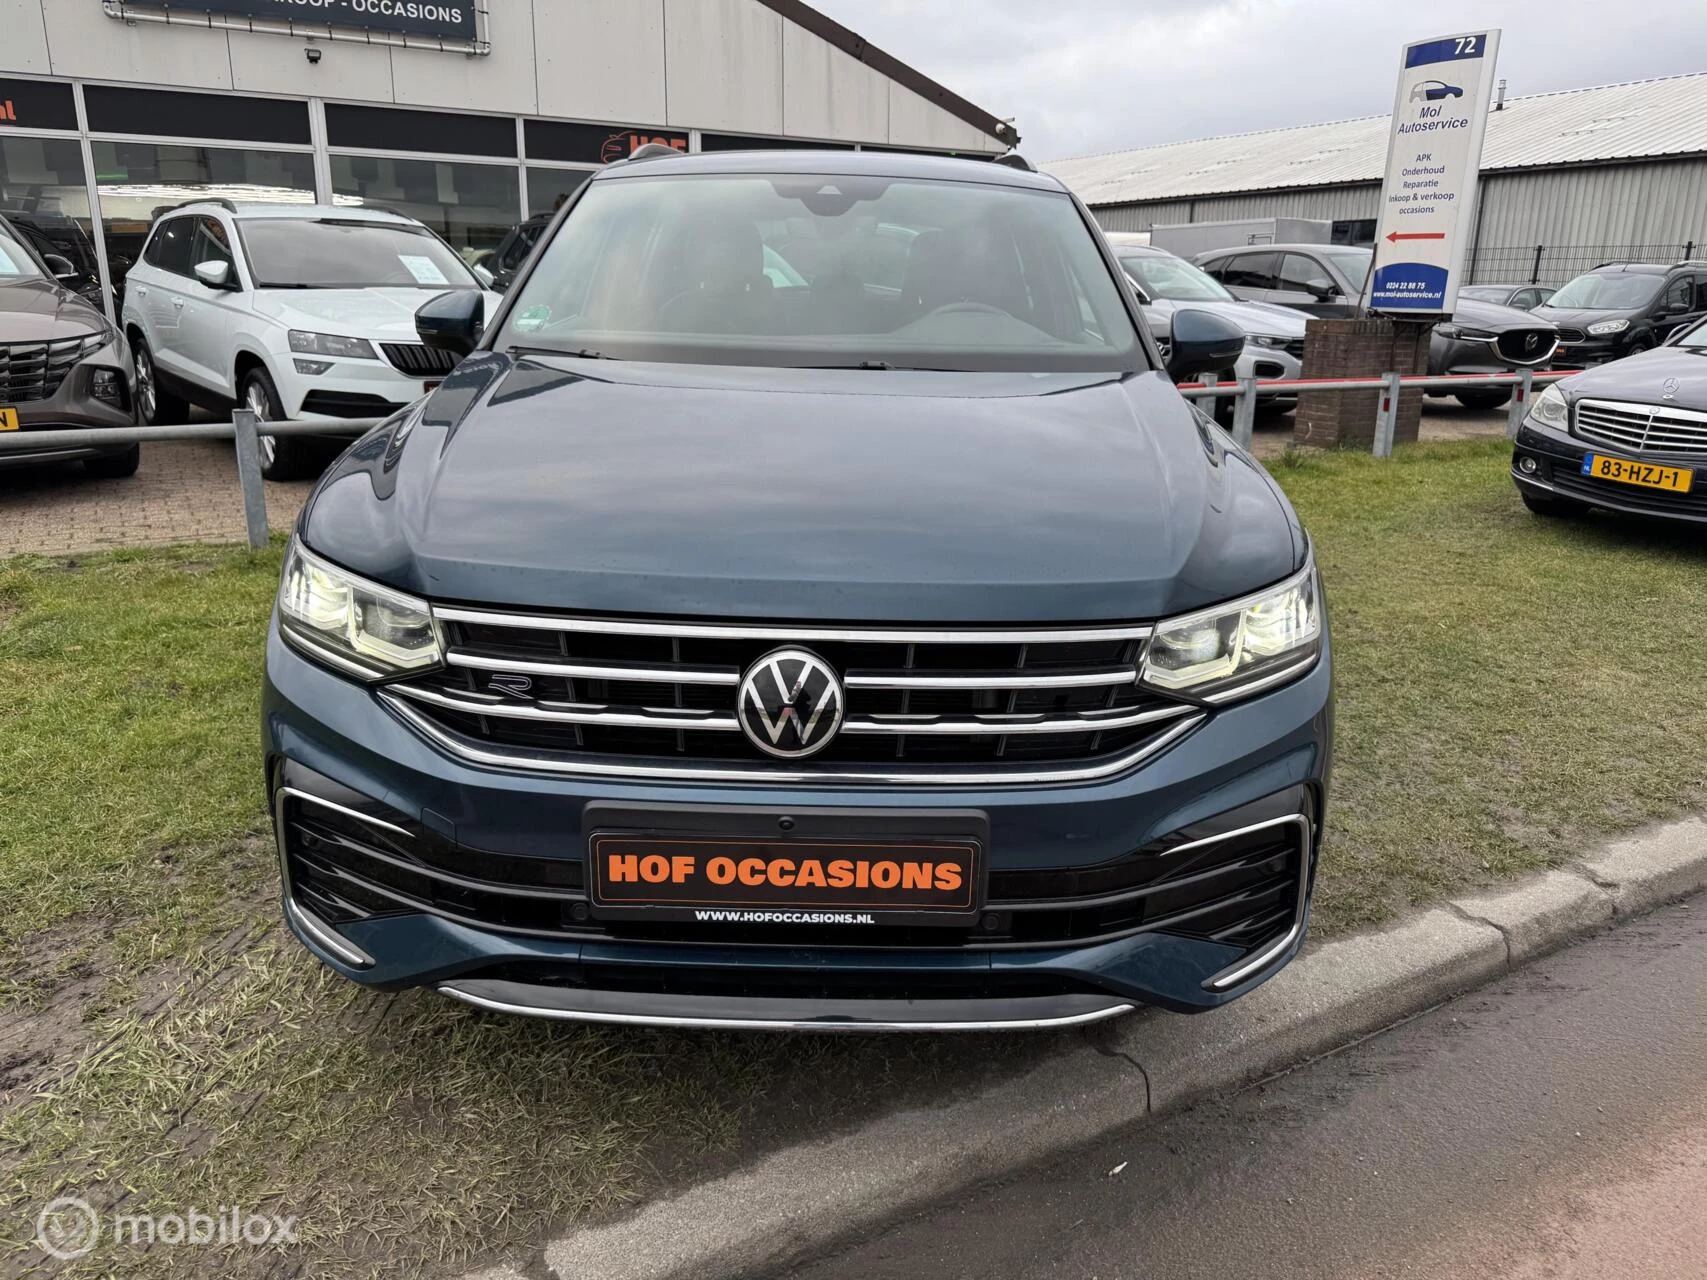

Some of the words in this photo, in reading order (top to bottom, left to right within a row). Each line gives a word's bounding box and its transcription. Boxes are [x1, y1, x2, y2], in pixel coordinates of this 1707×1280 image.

[352, 0, 462, 23] OCCASIONS
[1454, 36, 1477, 55] 72
[1420, 105, 1442, 119] Mol
[1398, 117, 1469, 135] Autoservice
[1416, 153, 1432, 163] APK
[1402, 166, 1445, 177] Onderhoud
[1403, 179, 1439, 190] Reparatie
[1412, 193, 1419, 201] &
[1420, 192, 1455, 201] verkoop
[1399, 205, 1435, 215] occasions
[1373, 290, 1442, 299] www.mol-autoservice.nl
[1600, 459, 1680, 488] 83-HZJ-1
[608, 854, 695, 884] HOF
[705, 856, 963, 891] OCCASIONS
[695, 910, 875, 924] WWW.HOFOCCASIONS.NL
